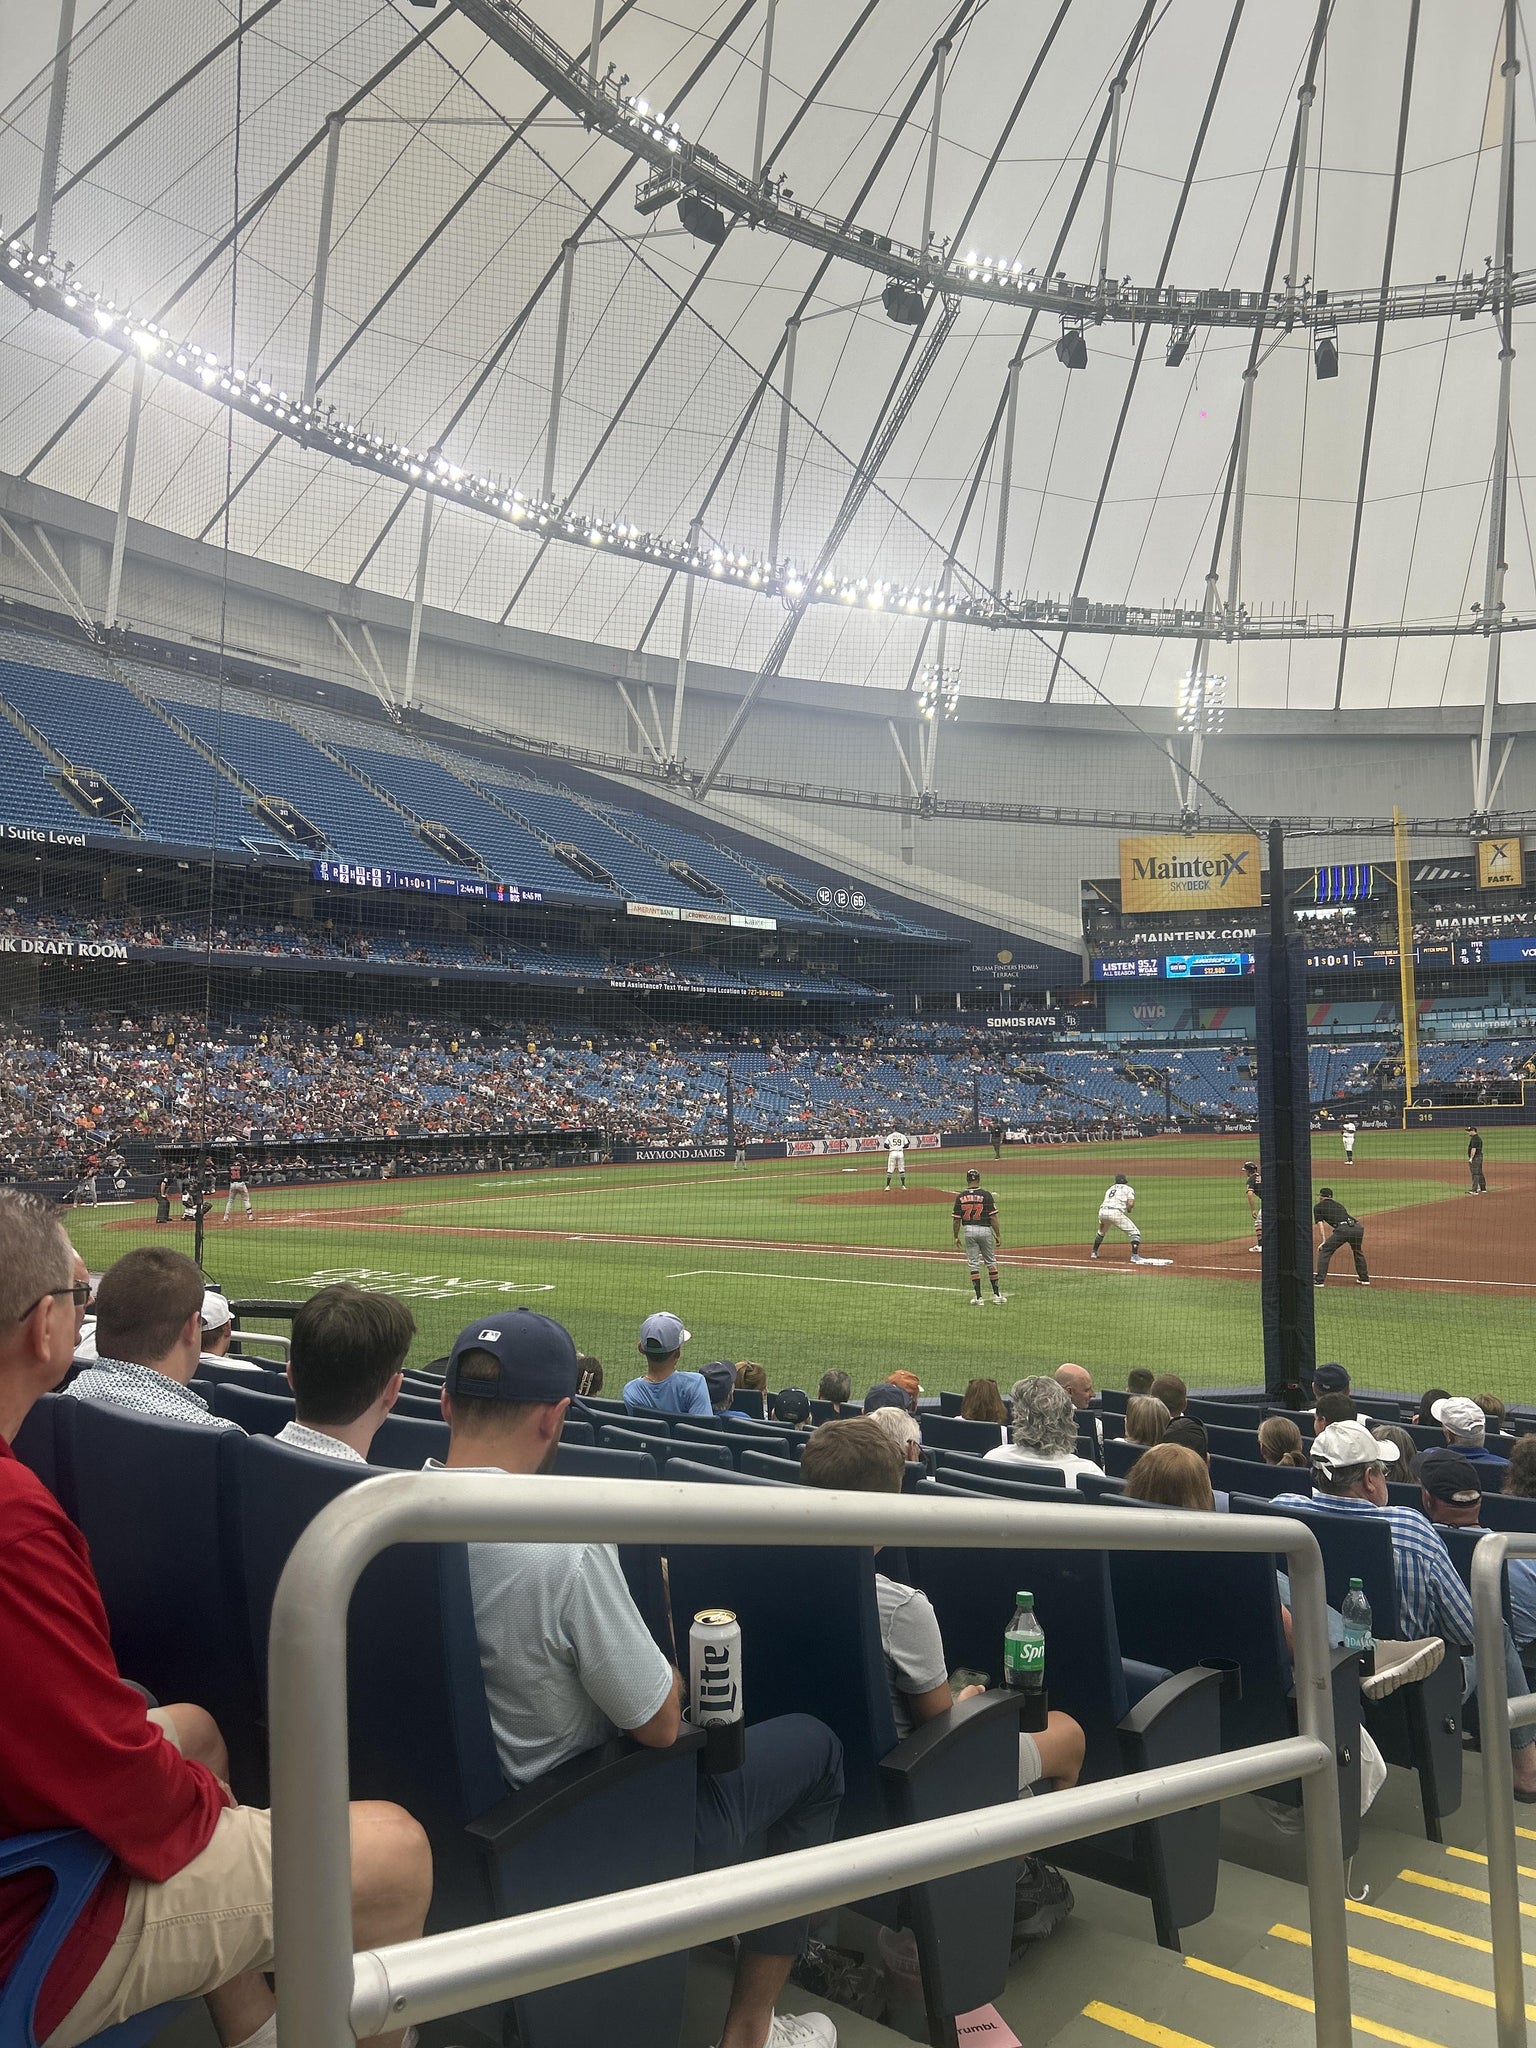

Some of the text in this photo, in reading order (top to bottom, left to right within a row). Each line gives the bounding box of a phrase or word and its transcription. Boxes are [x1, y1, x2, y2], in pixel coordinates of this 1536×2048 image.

[8, 826, 46, 842] Suite
[49, 830, 86, 846] Level
[333, 868, 339, 877] R
[350, 869, 355, 879] H
[1132, 850, 1249, 888] MaintenX
[366, 872, 371, 881] E
[1487, 874, 1514, 883] FAST.
[460, 884, 484, 894] 2:44 PM
[510, 885, 520, 894] BAL
[1170, 880, 1211, 891] SKYDECK
[510, 894, 520, 902] BOS
[534, 892, 542, 901] PM
[820, 891, 830, 902] 42
[838, 893, 846, 904] 12
[854, 896, 863, 906] 66
[1134, 928, 1257, 942] MAINTENX.COM
[21, 940, 74, 956] DRAFT
[79, 944, 128, 959] ROOM
[1137, 959, 1157, 968] 95.7
[1327, 955, 1335, 966] 0
[972, 964, 993, 972] DREAM
[1102, 962, 1135, 971] LISTEN
[610, 980, 626, 988] Need
[627, 981, 663, 990] Assistance?
[677, 984, 690, 992] Your
[717, 986, 740, 995] Location
[1132, 1004, 1166, 1018] VIVA
[986, 1018, 1026, 1027] SOMOS
[1028, 1016, 1056, 1026] RAYS
[1419, 1114, 1433, 1122] 315
[1225, 1123, 1253, 1132] Hard Rock
[892, 1139, 902, 1147] 59
[636, 1148, 726, 1160] RAYMOND JAMES
[1109, 1190, 1116, 1198] 8
[961, 1204, 984, 1220] 77
[700, 1645, 737, 1713] Lite
[1344, 1749, 1350, 1762] H
